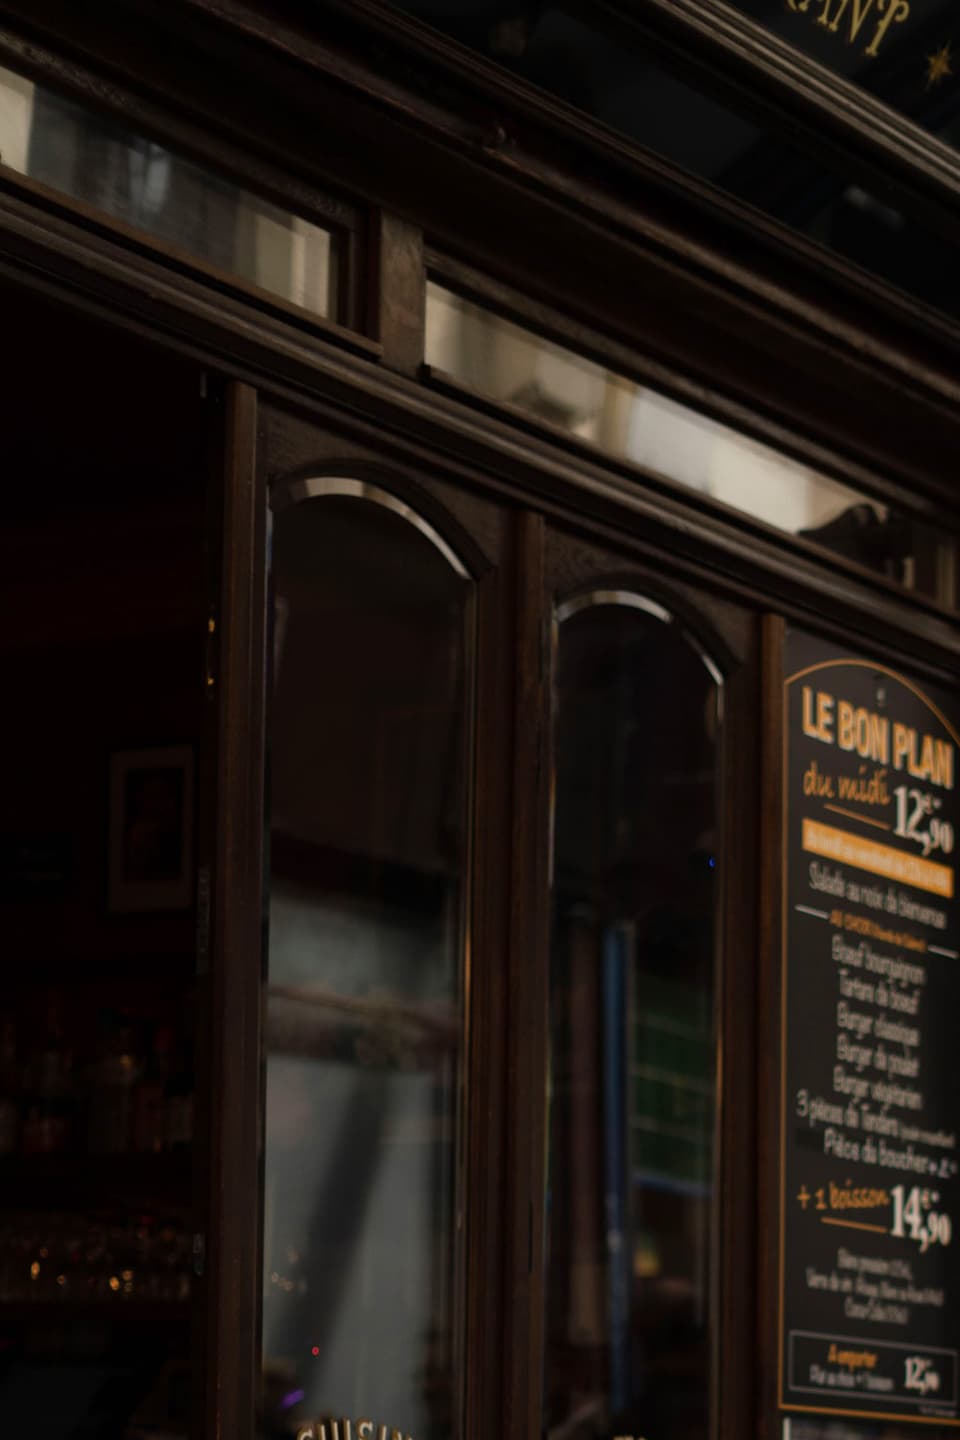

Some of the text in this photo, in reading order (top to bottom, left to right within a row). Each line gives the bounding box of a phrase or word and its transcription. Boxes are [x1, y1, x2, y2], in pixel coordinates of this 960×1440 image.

[803, 686, 955, 789] LE BON PLAN
[803, 761, 891, 806] du midi
[828, 1178, 891, 1211] boisson
